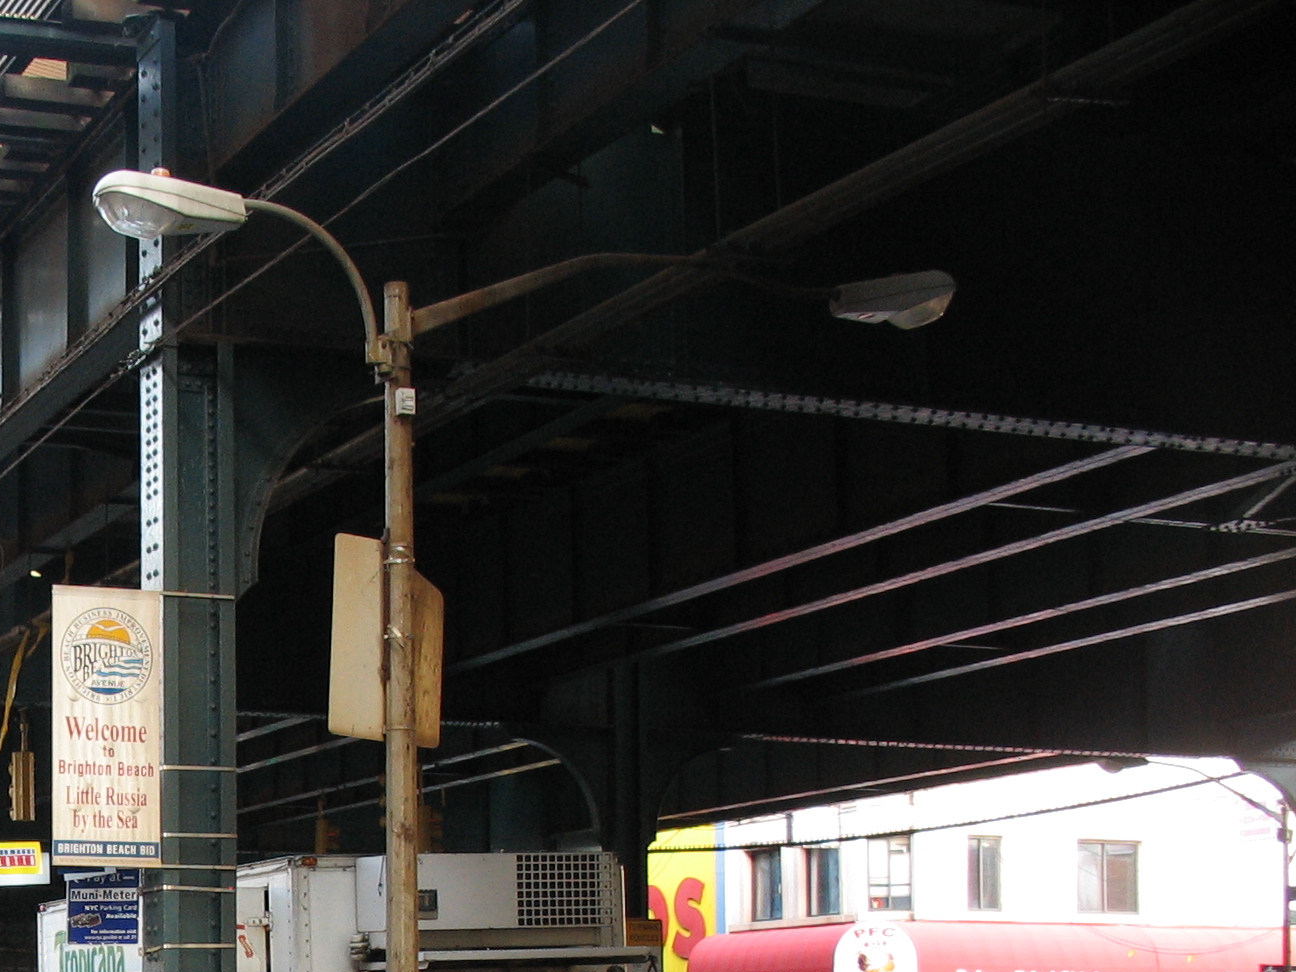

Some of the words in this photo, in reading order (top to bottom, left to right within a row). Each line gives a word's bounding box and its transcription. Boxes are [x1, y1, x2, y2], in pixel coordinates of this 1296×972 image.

[65, 715, 147, 744] Welcome
[102, 745, 115, 757] to
[58, 759, 112, 777] Brighton
[117, 762, 155, 778] Beach
[66, 786, 101, 806] Little
[105, 787, 148, 807] Russia
[73, 809, 89, 834] by
[93, 810, 113, 829] the
[116, 810, 138, 830] Sea
[57, 842, 104, 855] BRIGHTON
[106, 844, 137, 855] BEACH
[139, 845, 155, 856] BID
[71, 889, 136, 900] Muni-Meter
[854, 926, 896, 939] PFC
